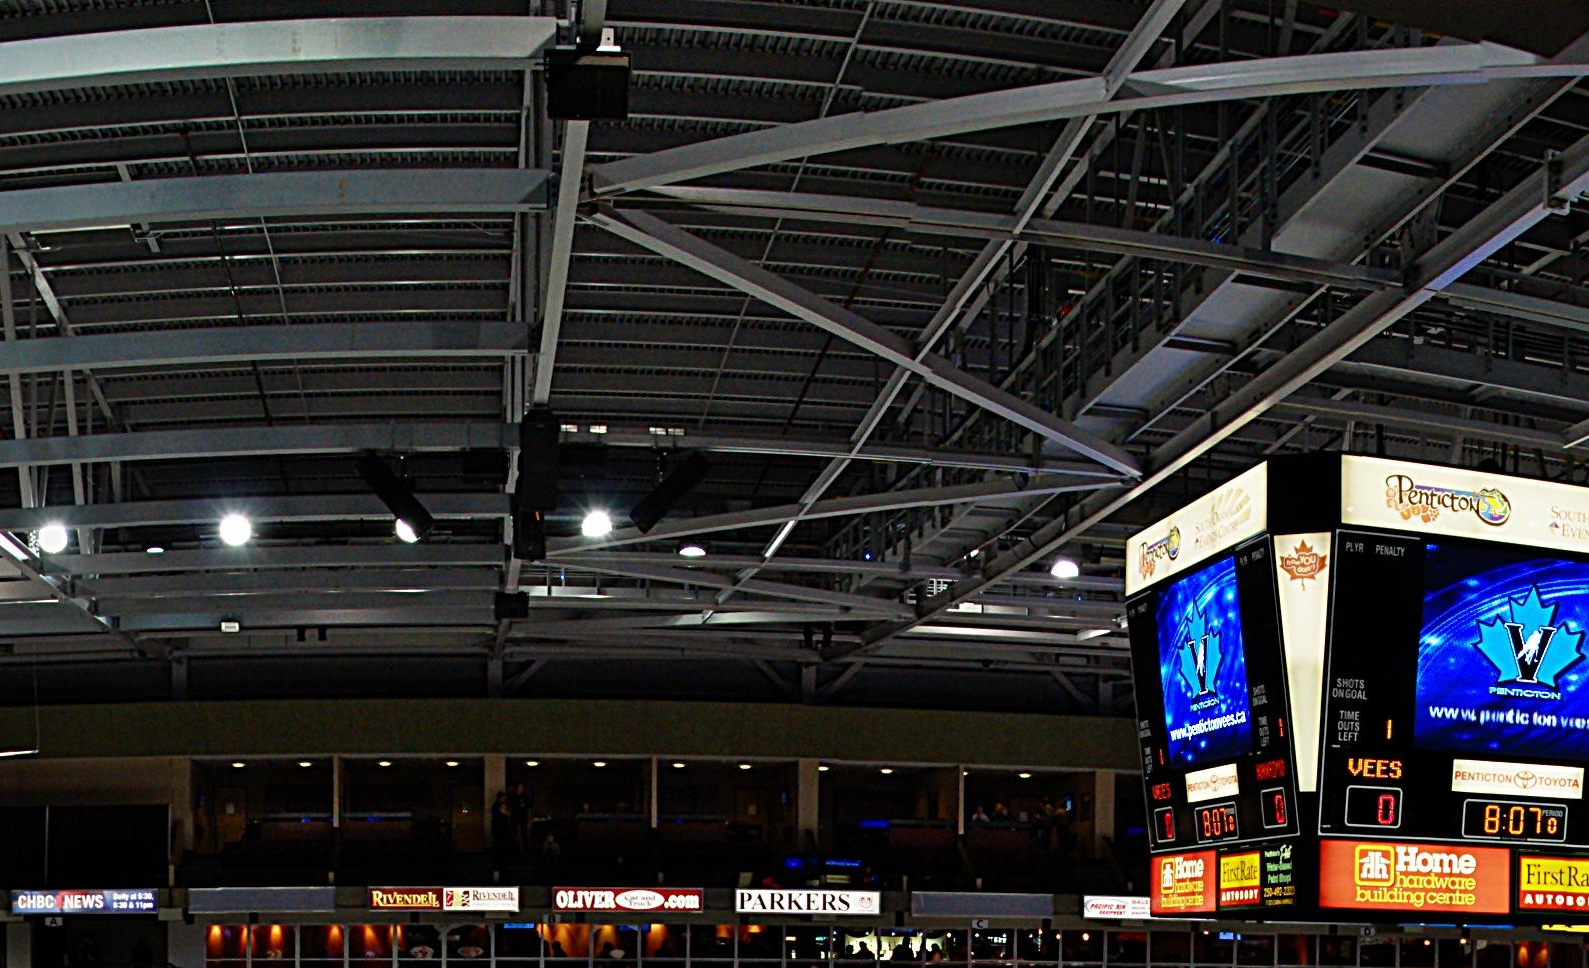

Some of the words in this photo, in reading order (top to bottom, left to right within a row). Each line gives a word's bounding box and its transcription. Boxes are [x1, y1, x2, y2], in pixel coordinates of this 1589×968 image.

[1386, 475, 1479, 514] Penticton
[1345, 541, 1364, 553] PLYR
[1375, 544, 1405, 558] PENALTY
[1336, 678, 1365, 689] SHOTS
[1489, 686, 1561, 700] PENTICTON
[1339, 710, 1360, 722] TIME
[1337, 721, 1360, 732] OUTS
[1386, 719, 1393, 739] 1
[1338, 731, 1359, 742] LEFT
[1347, 758, 1402, 779] VEES
[1454, 772, 1512, 784] PENTICTON
[1538, 776, 1580, 789] TOYOTA
[1274, 794, 1285, 824] 0
[1377, 794, 1395, 824] 0
[1542, 808, 1563, 819] PERIOD
[1175, 857, 1204, 878] Home
[1396, 846, 1476, 874] Home
[1222, 862, 1240, 883] First
[1240, 861, 1258, 881] Rate
[1526, 863, 1566, 885] First
[1174, 880, 1203, 892] hardware
[1395, 874, 1476, 891] hardware
[17, 894, 54, 909] CHBC
[63, 894, 104, 909] NEWS
[556, 890, 616, 910] OLIVER
[627, 900, 653, 908] Truck
[663, 892, 700, 909] .com
[739, 892, 851, 911] PARKERS
[1162, 894, 1185, 909] building
[1186, 893, 1203, 906] centre
[1221, 889, 1259, 902] AUTOBODY
[1356, 887, 1424, 907] building
[1426, 890, 1476, 906] centre
